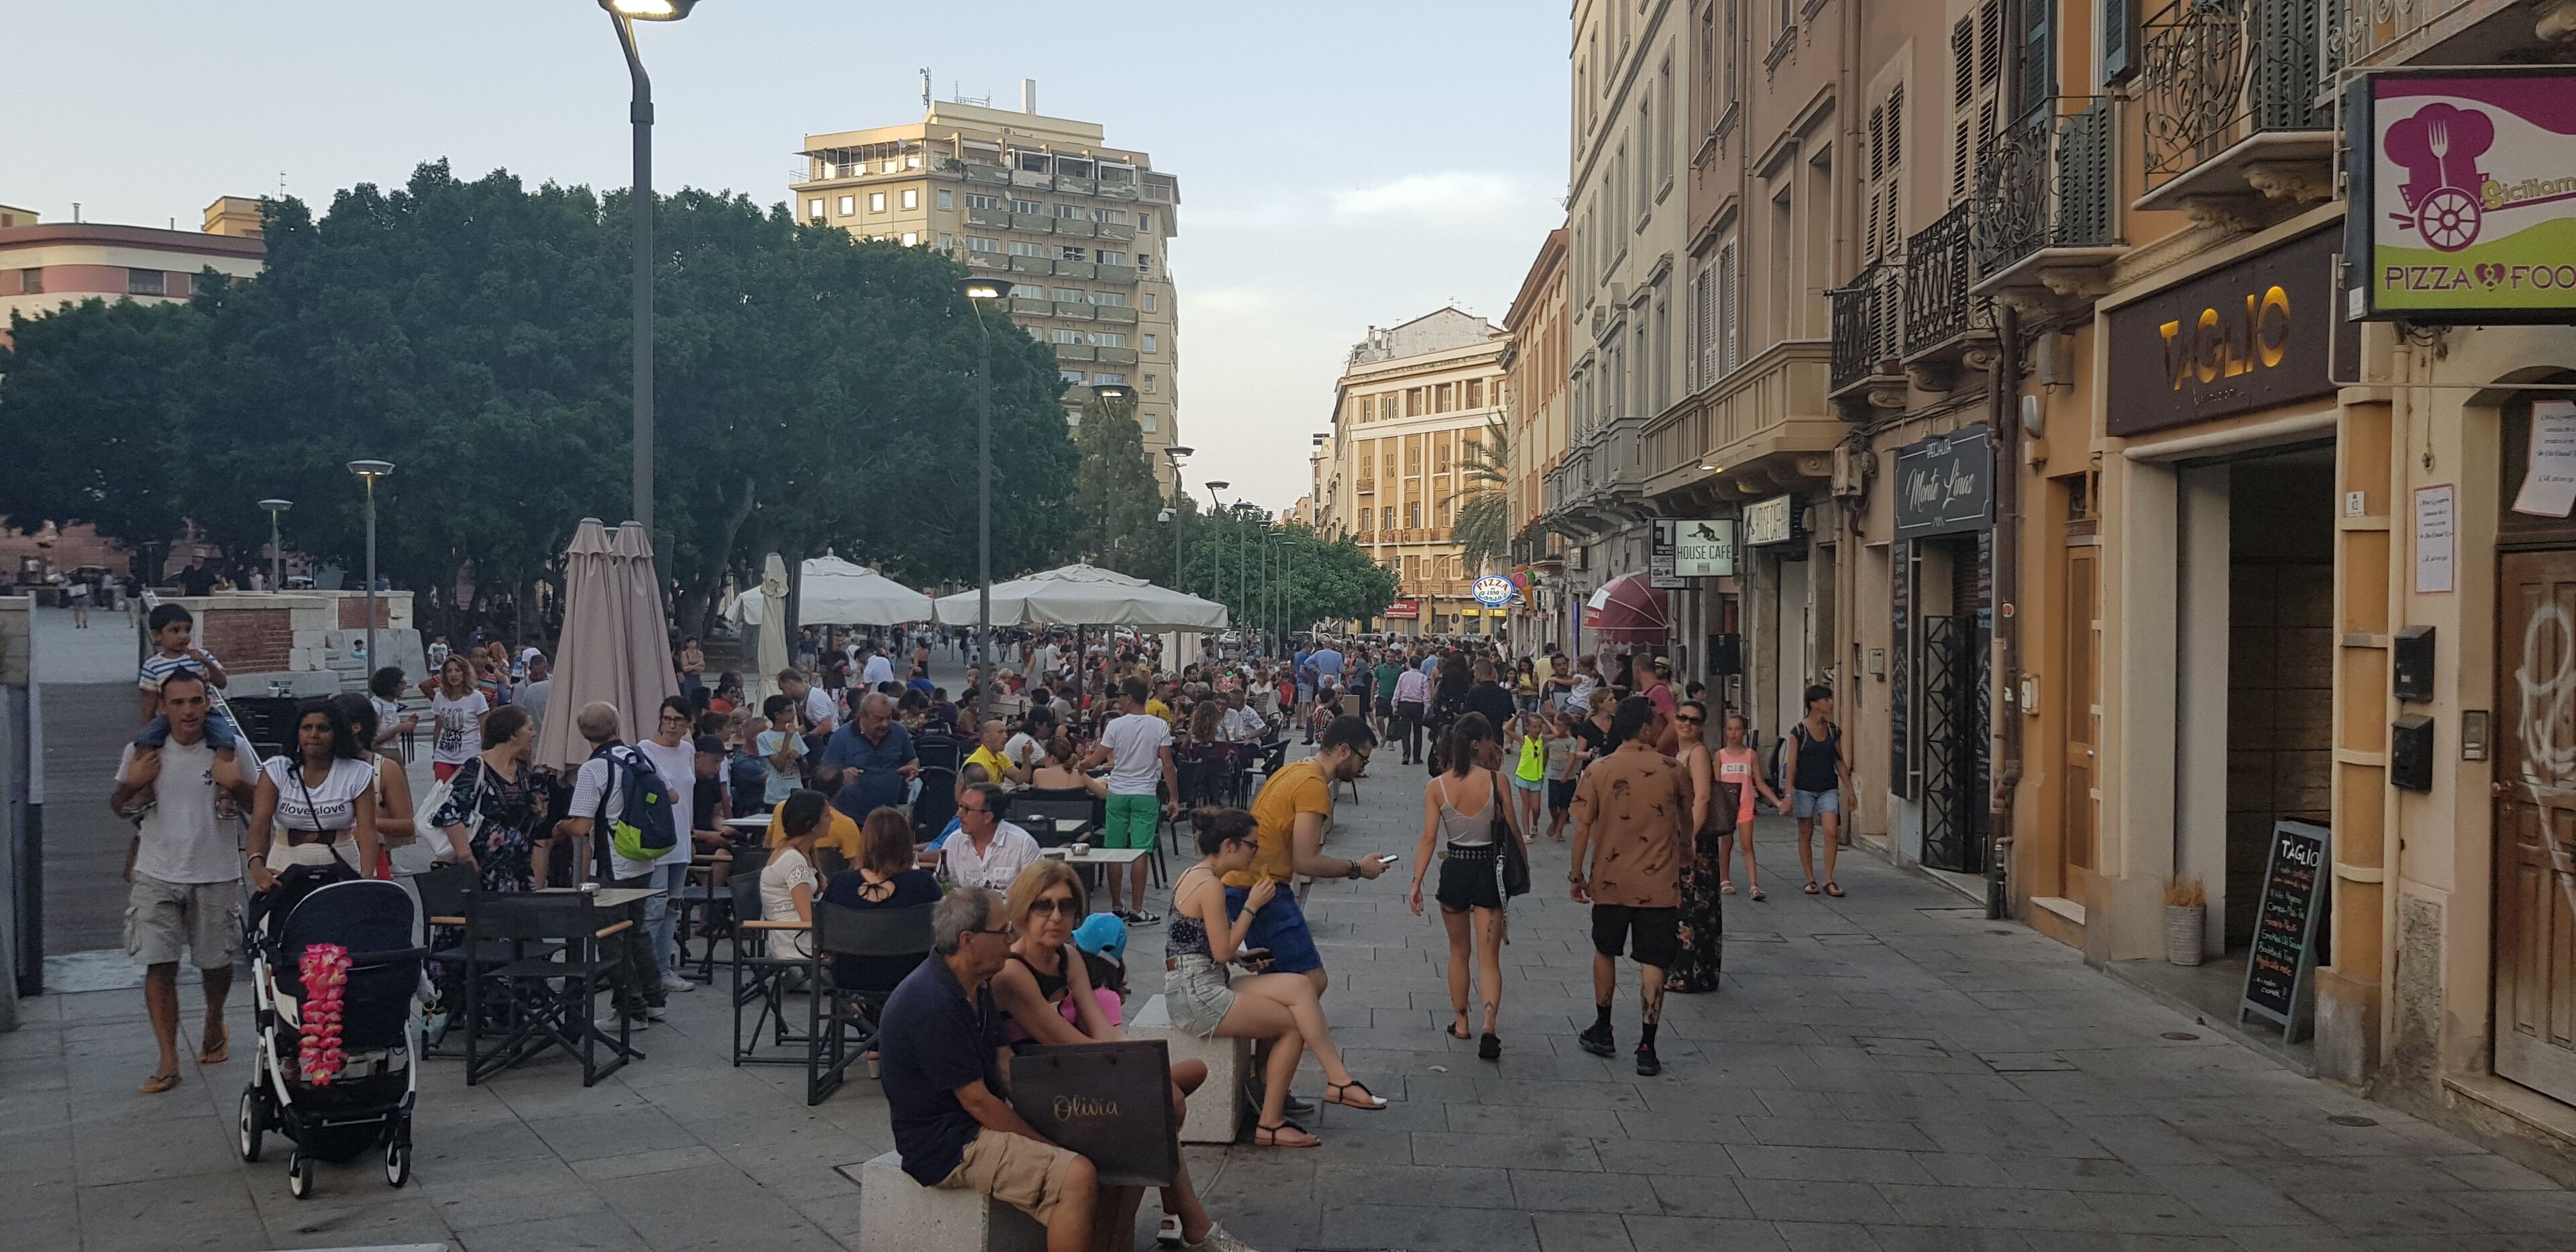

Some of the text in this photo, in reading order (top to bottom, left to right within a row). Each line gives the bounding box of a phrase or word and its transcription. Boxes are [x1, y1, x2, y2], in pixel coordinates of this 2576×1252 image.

[2384, 266, 2473, 291] PIZZA
[2159, 285, 2290, 397] TAGLIO
[1906, 468, 1941, 512] Monte
[1677, 544, 1731, 560] HOUSE CAFÉ
[1477, 578, 1509, 591] PIZZA
[1726, 764, 1745, 772] CLUB
[279, 802, 345, 816] #loveslove
[2282, 835, 2319, 867] TAGLIO
[1053, 1095, 1120, 1121] Olivia
